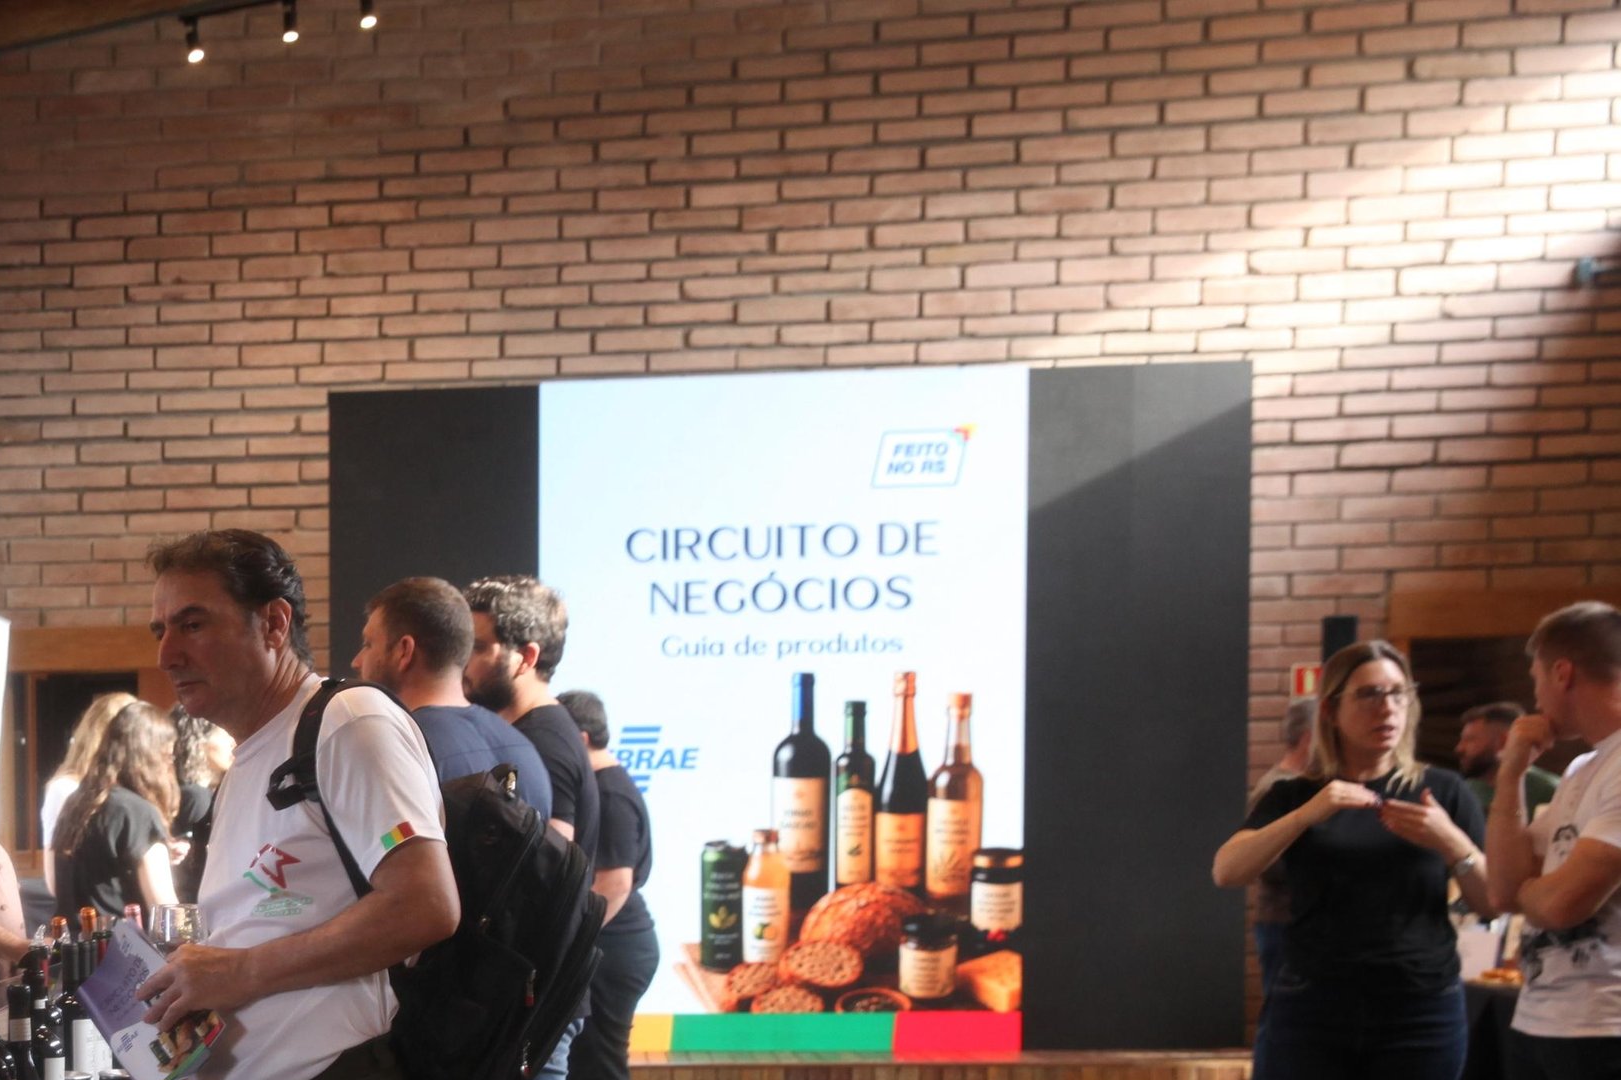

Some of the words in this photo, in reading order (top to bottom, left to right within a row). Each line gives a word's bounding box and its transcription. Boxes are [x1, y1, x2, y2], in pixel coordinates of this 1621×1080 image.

[893, 442, 949, 457] FEITO
[886, 461, 914, 474] NO
[921, 460, 946, 473] RS
[625, 523, 859, 562] CIRCUITO
[879, 520, 939, 556] DE
[649, 571, 913, 615] NEGÓCIOS
[661, 634, 725, 657] Guia
[734, 633, 767, 656] de
[778, 633, 903, 660] produtos
[610, 748, 699, 769] BRAE
